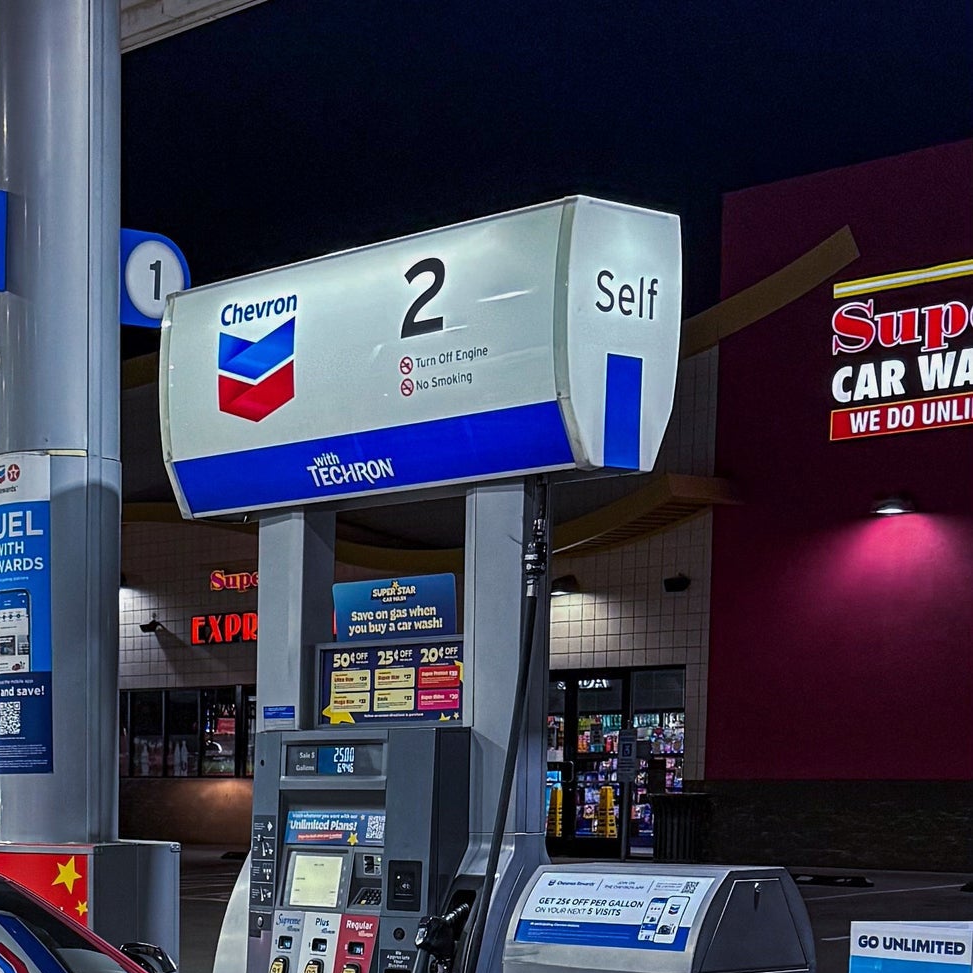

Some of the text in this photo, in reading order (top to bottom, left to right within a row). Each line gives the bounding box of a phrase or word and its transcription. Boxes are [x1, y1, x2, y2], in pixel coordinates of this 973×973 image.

[149, 259, 162, 300] 1
[400, 257, 446, 339] 2
[594, 270, 659, 321] Self
[221, 294, 297, 326] Chevron
[832, 299, 973, 356] Sup
[416, 347, 488, 368] Turn Off Engine
[416, 373, 472, 391] No Smoking
[831, 359, 906, 403] CAR
[850, 397, 973, 434] WE DO UNLI
[313, 452, 340, 467] with
[307, 458, 394, 487] TECHRON
[372, 585, 416, 597] SUPER STAR
[351, 605, 436, 621] Save on gas when
[349, 617, 443, 636] you buy a car wash!
[333, 652, 368, 668] 50¢ OFF
[378, 649, 398, 665] 25¢
[420, 647, 443, 663] 20¢
[445, 647, 458, 655] OFF
[1, 686, 14, 696] and
[17, 685, 44, 696] save!
[290, 819, 357, 831] Unlimited Plans!
[595, 908, 621, 916] VISITS
[608, 900, 644, 908] GALLON
[276, 913, 301, 927] Supreme
[315, 918, 329, 926] Plus
[346, 920, 373, 931] Regular
[858, 935, 966, 956] GO UNLIMITED
